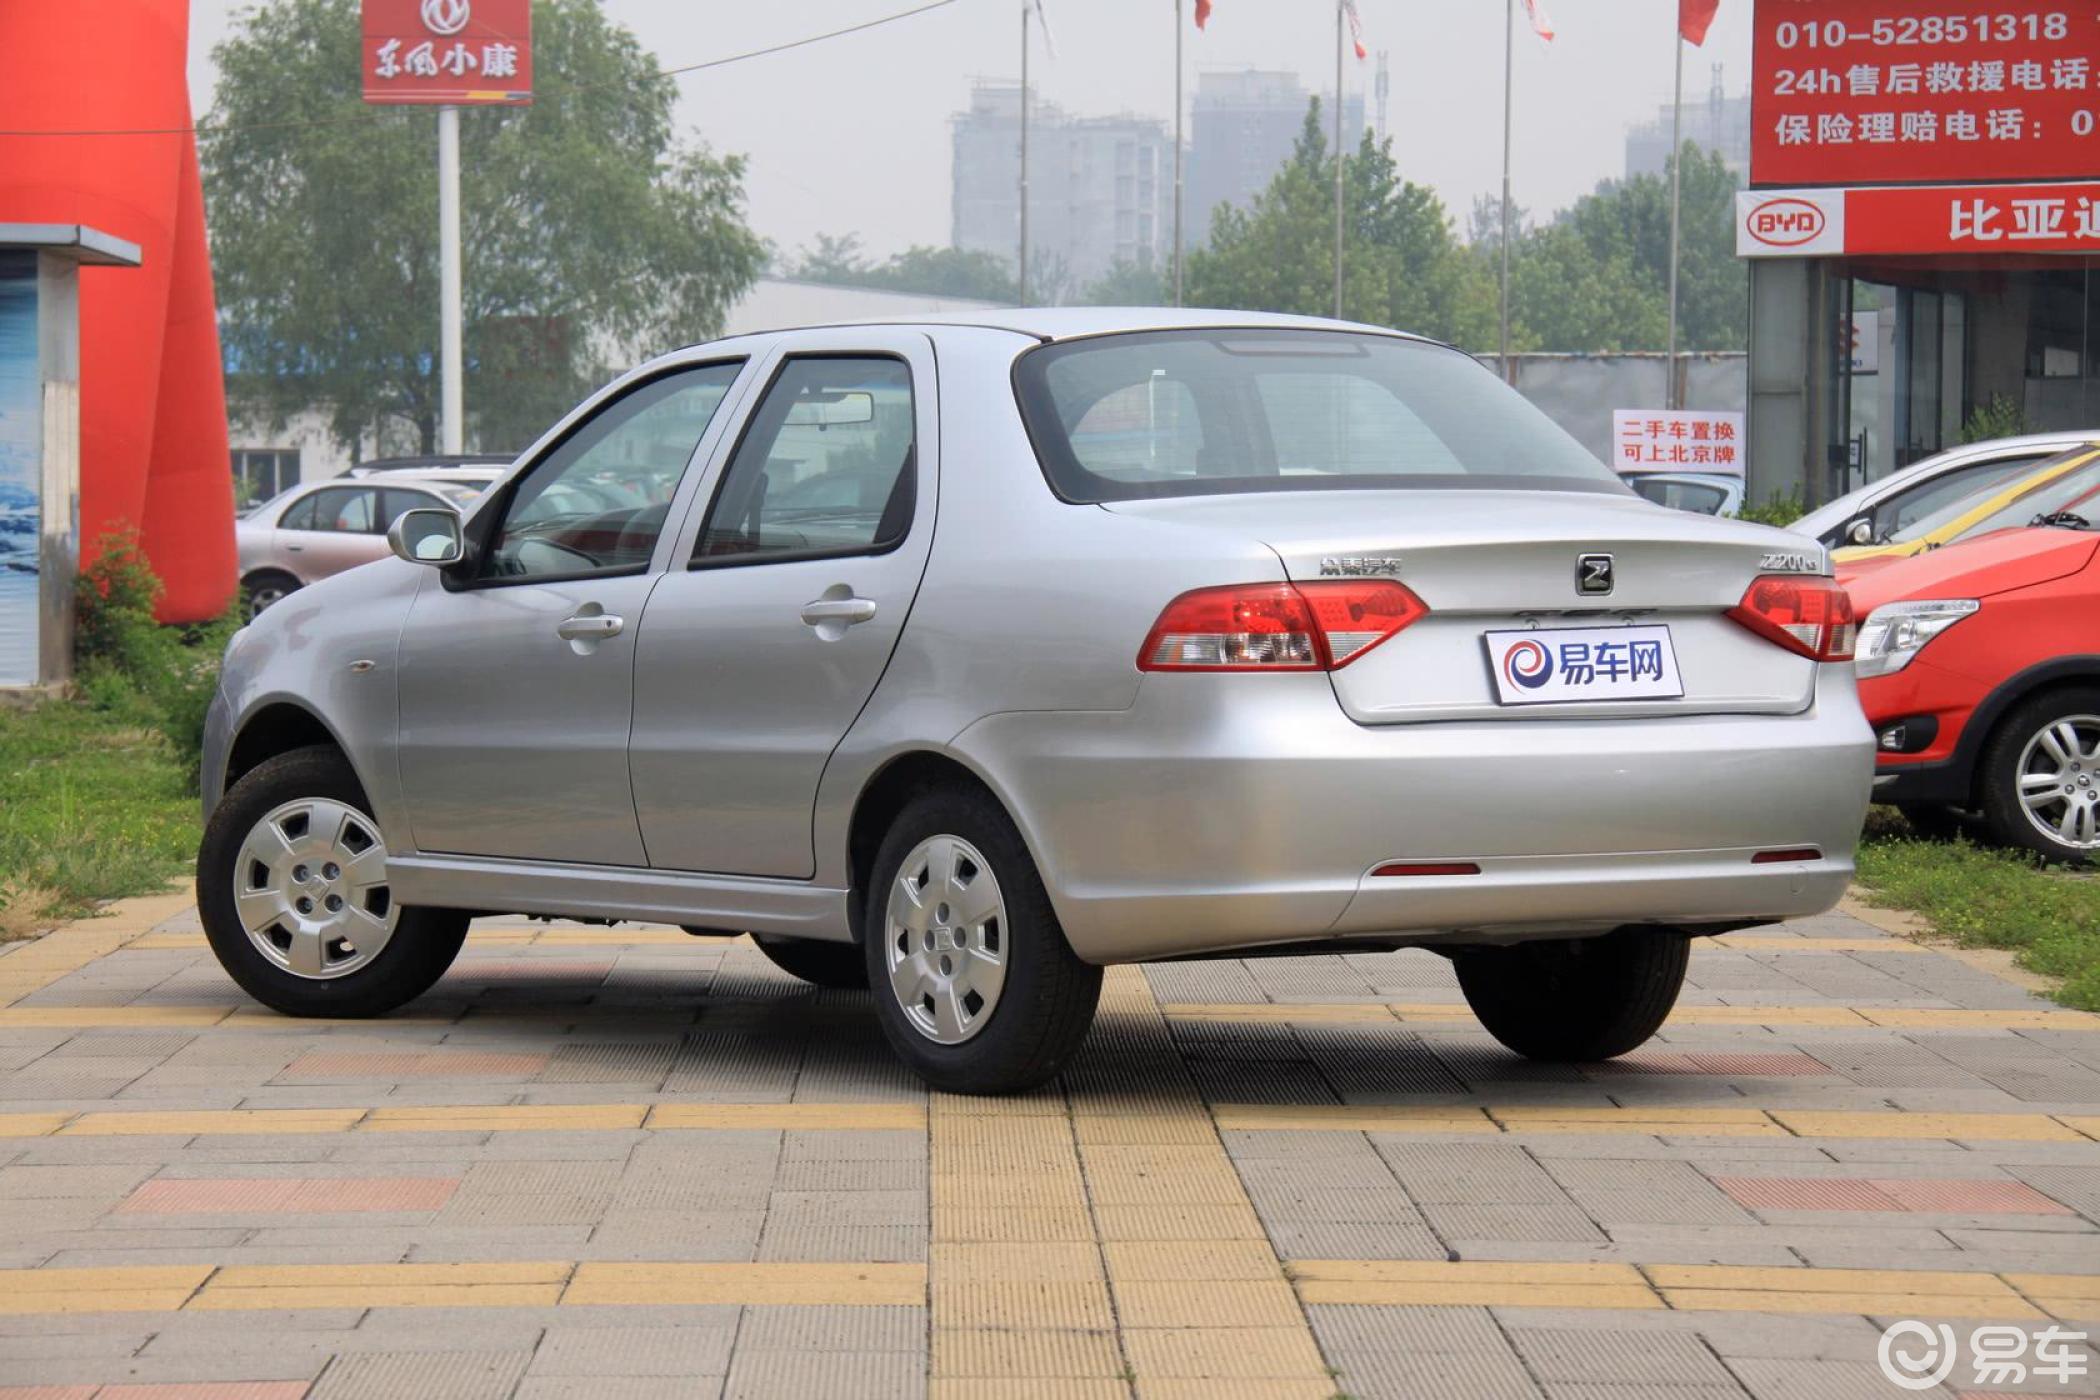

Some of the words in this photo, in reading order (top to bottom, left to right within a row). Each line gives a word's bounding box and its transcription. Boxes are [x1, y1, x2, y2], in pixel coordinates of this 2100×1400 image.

[1775, 12, 2068, 49] 010-52851318
[375, 38, 517, 78] 东风小康
[2070, 108, 2100, 136] 0
[1757, 212, 1815, 233] BYD
[1622, 420, 1735, 441] 二手车置换
[1622, 443, 1736, 464] 可上北京牌
[1559, 640, 1663, 686] 易车网
